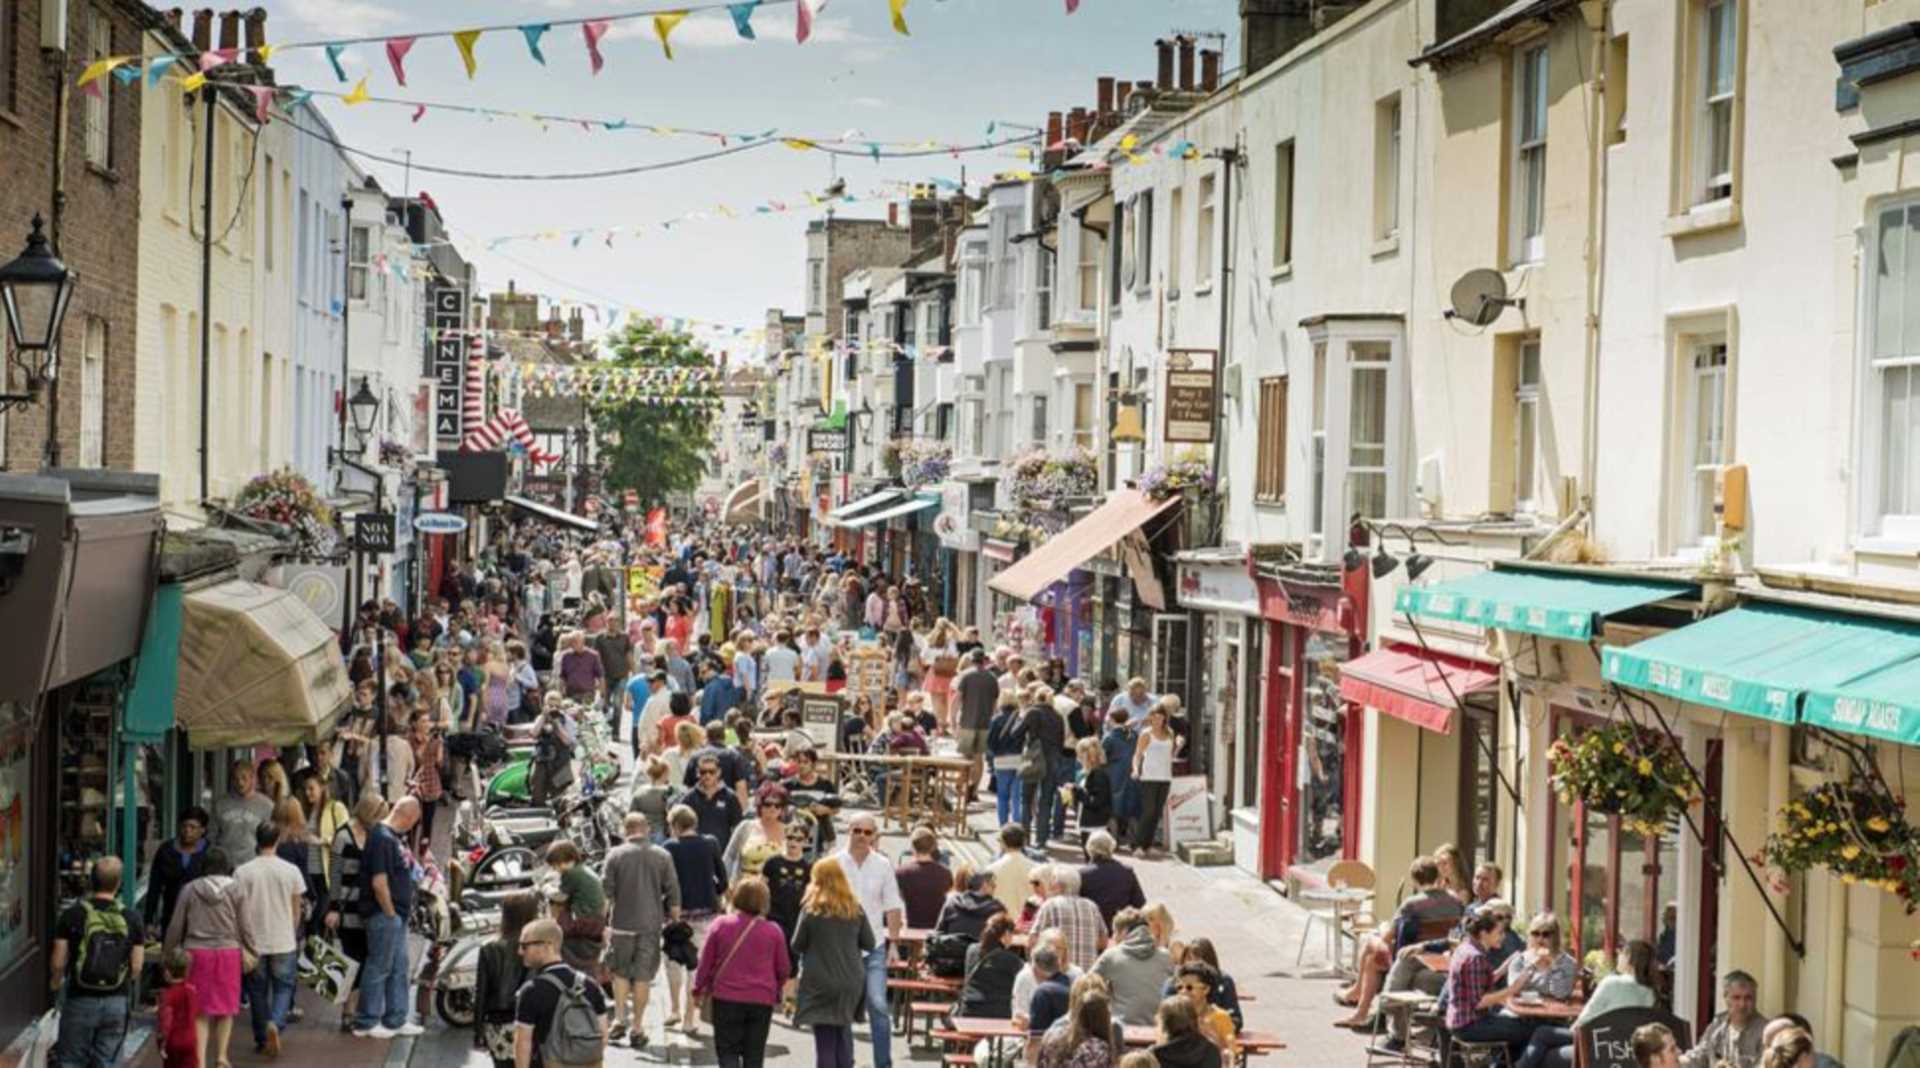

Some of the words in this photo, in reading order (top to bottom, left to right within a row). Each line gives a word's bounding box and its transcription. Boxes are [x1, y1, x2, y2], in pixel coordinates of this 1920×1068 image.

[439, 295, 455, 432] CINEMA
[361, 521, 389, 534] NOA
[361, 533, 389, 545] NOA
